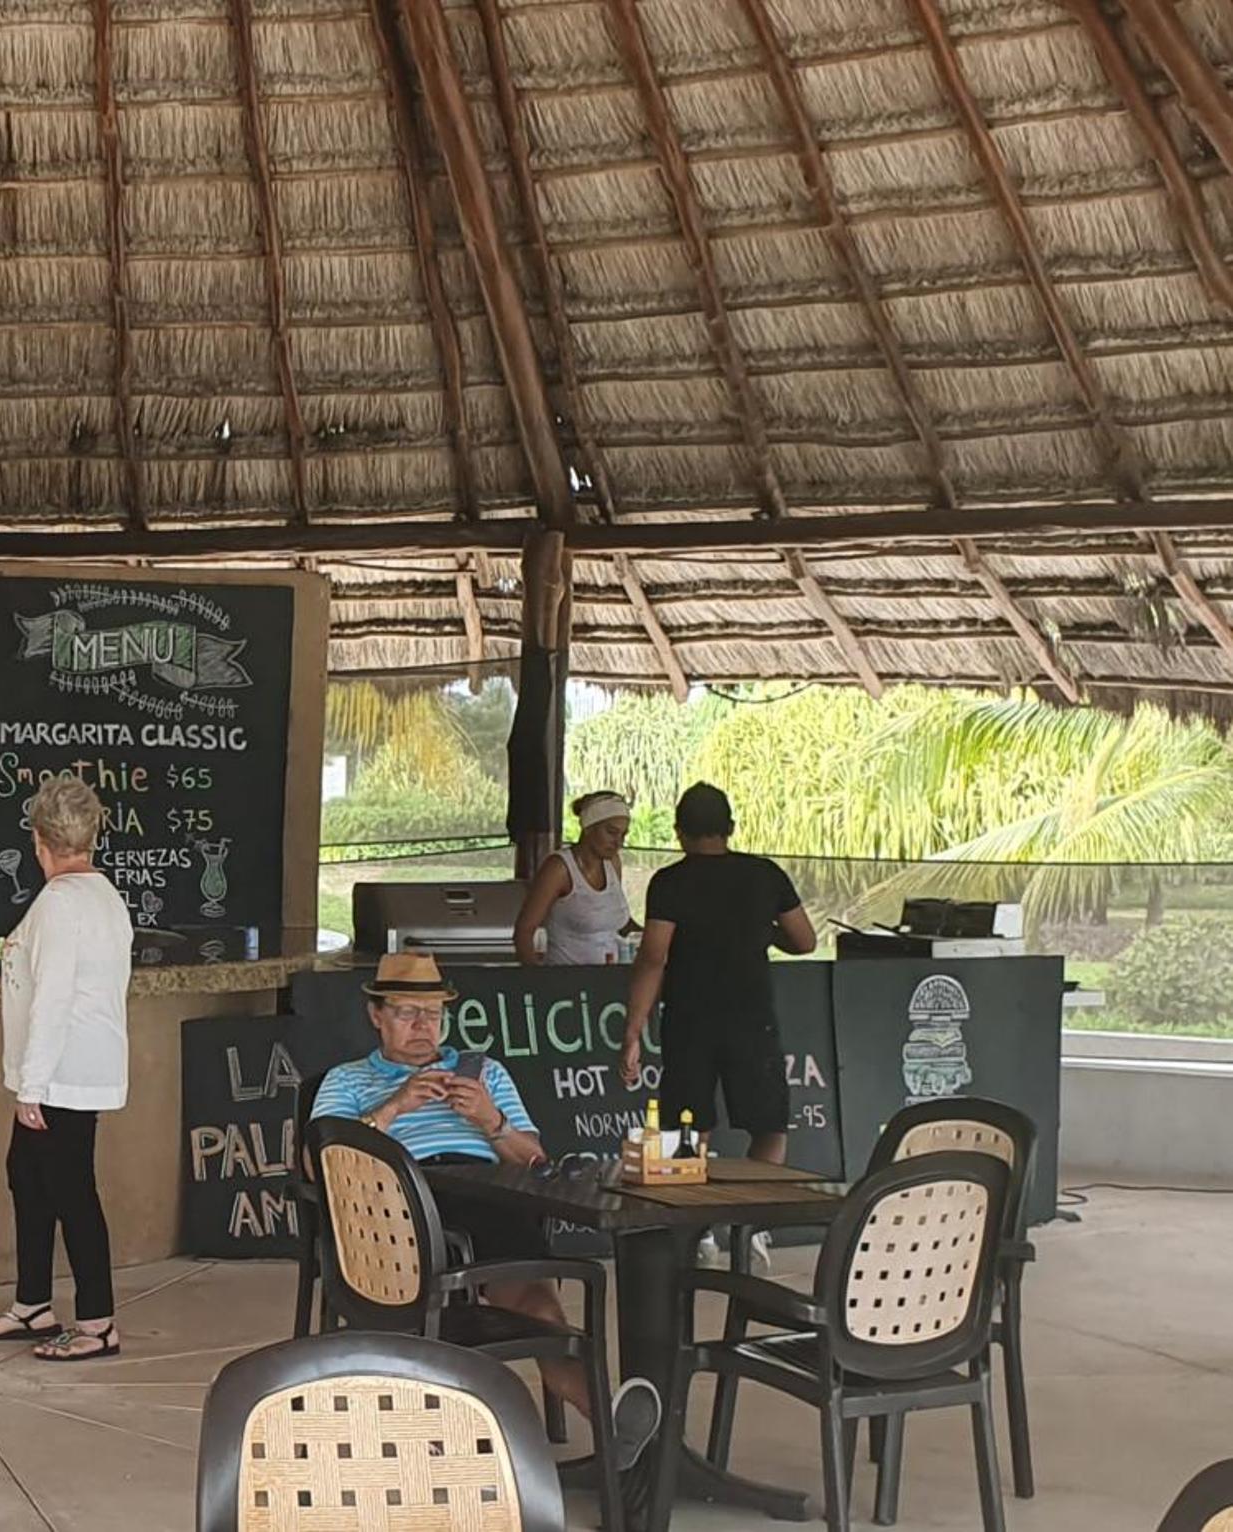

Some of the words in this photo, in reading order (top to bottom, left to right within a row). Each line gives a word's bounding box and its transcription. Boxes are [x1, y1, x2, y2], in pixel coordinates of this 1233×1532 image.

[72, 627, 174, 670] MENU
[0, 722, 135, 746] MARGARITA
[140, 724, 247, 750] CLASSIC
[167, 764, 213, 789] $65
[167, 808, 214, 834] $75
[101, 848, 192, 869] CERVEZAS
[114, 868, 166, 889] FRIAS
[226, 1041, 303, 1101] LA
[553, 1064, 609, 1099] HOT
